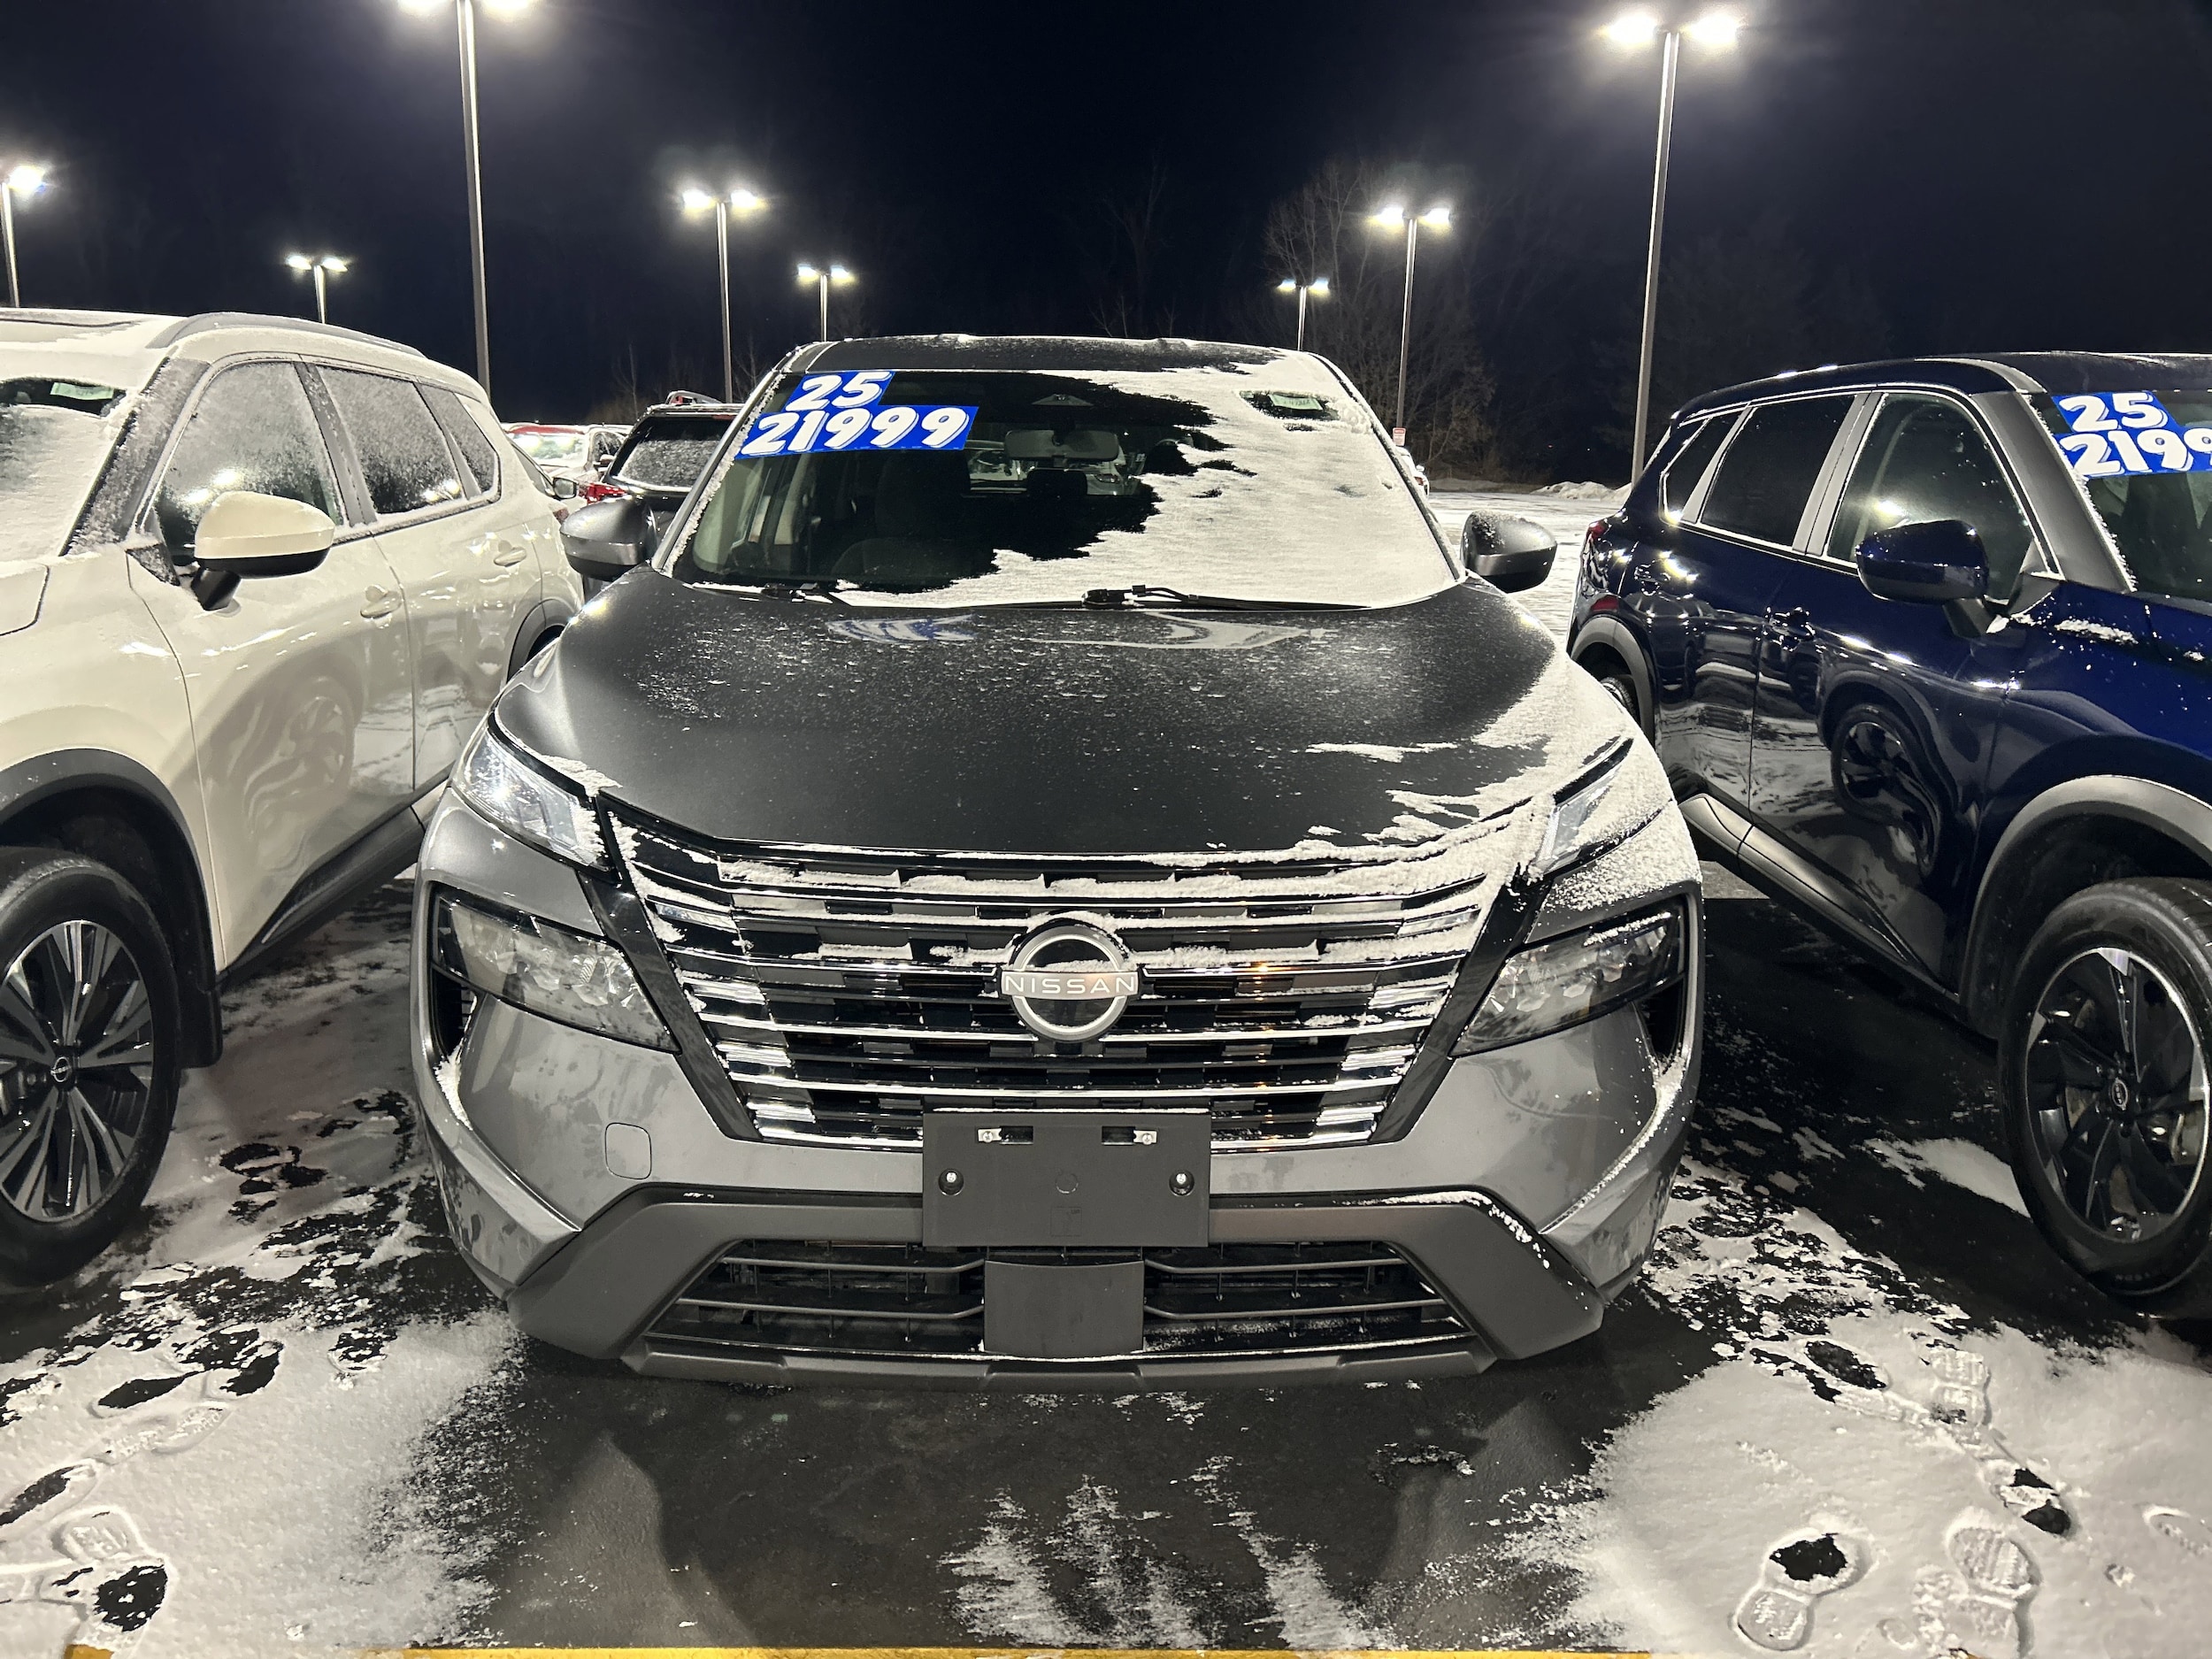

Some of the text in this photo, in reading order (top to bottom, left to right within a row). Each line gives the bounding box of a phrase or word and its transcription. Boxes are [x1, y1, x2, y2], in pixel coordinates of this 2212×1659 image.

[786, 371, 893, 411] 25
[741, 406, 970, 456] 21999
[2059, 392, 2169, 433] 25
[1005, 975, 1134, 995] NISSAN
